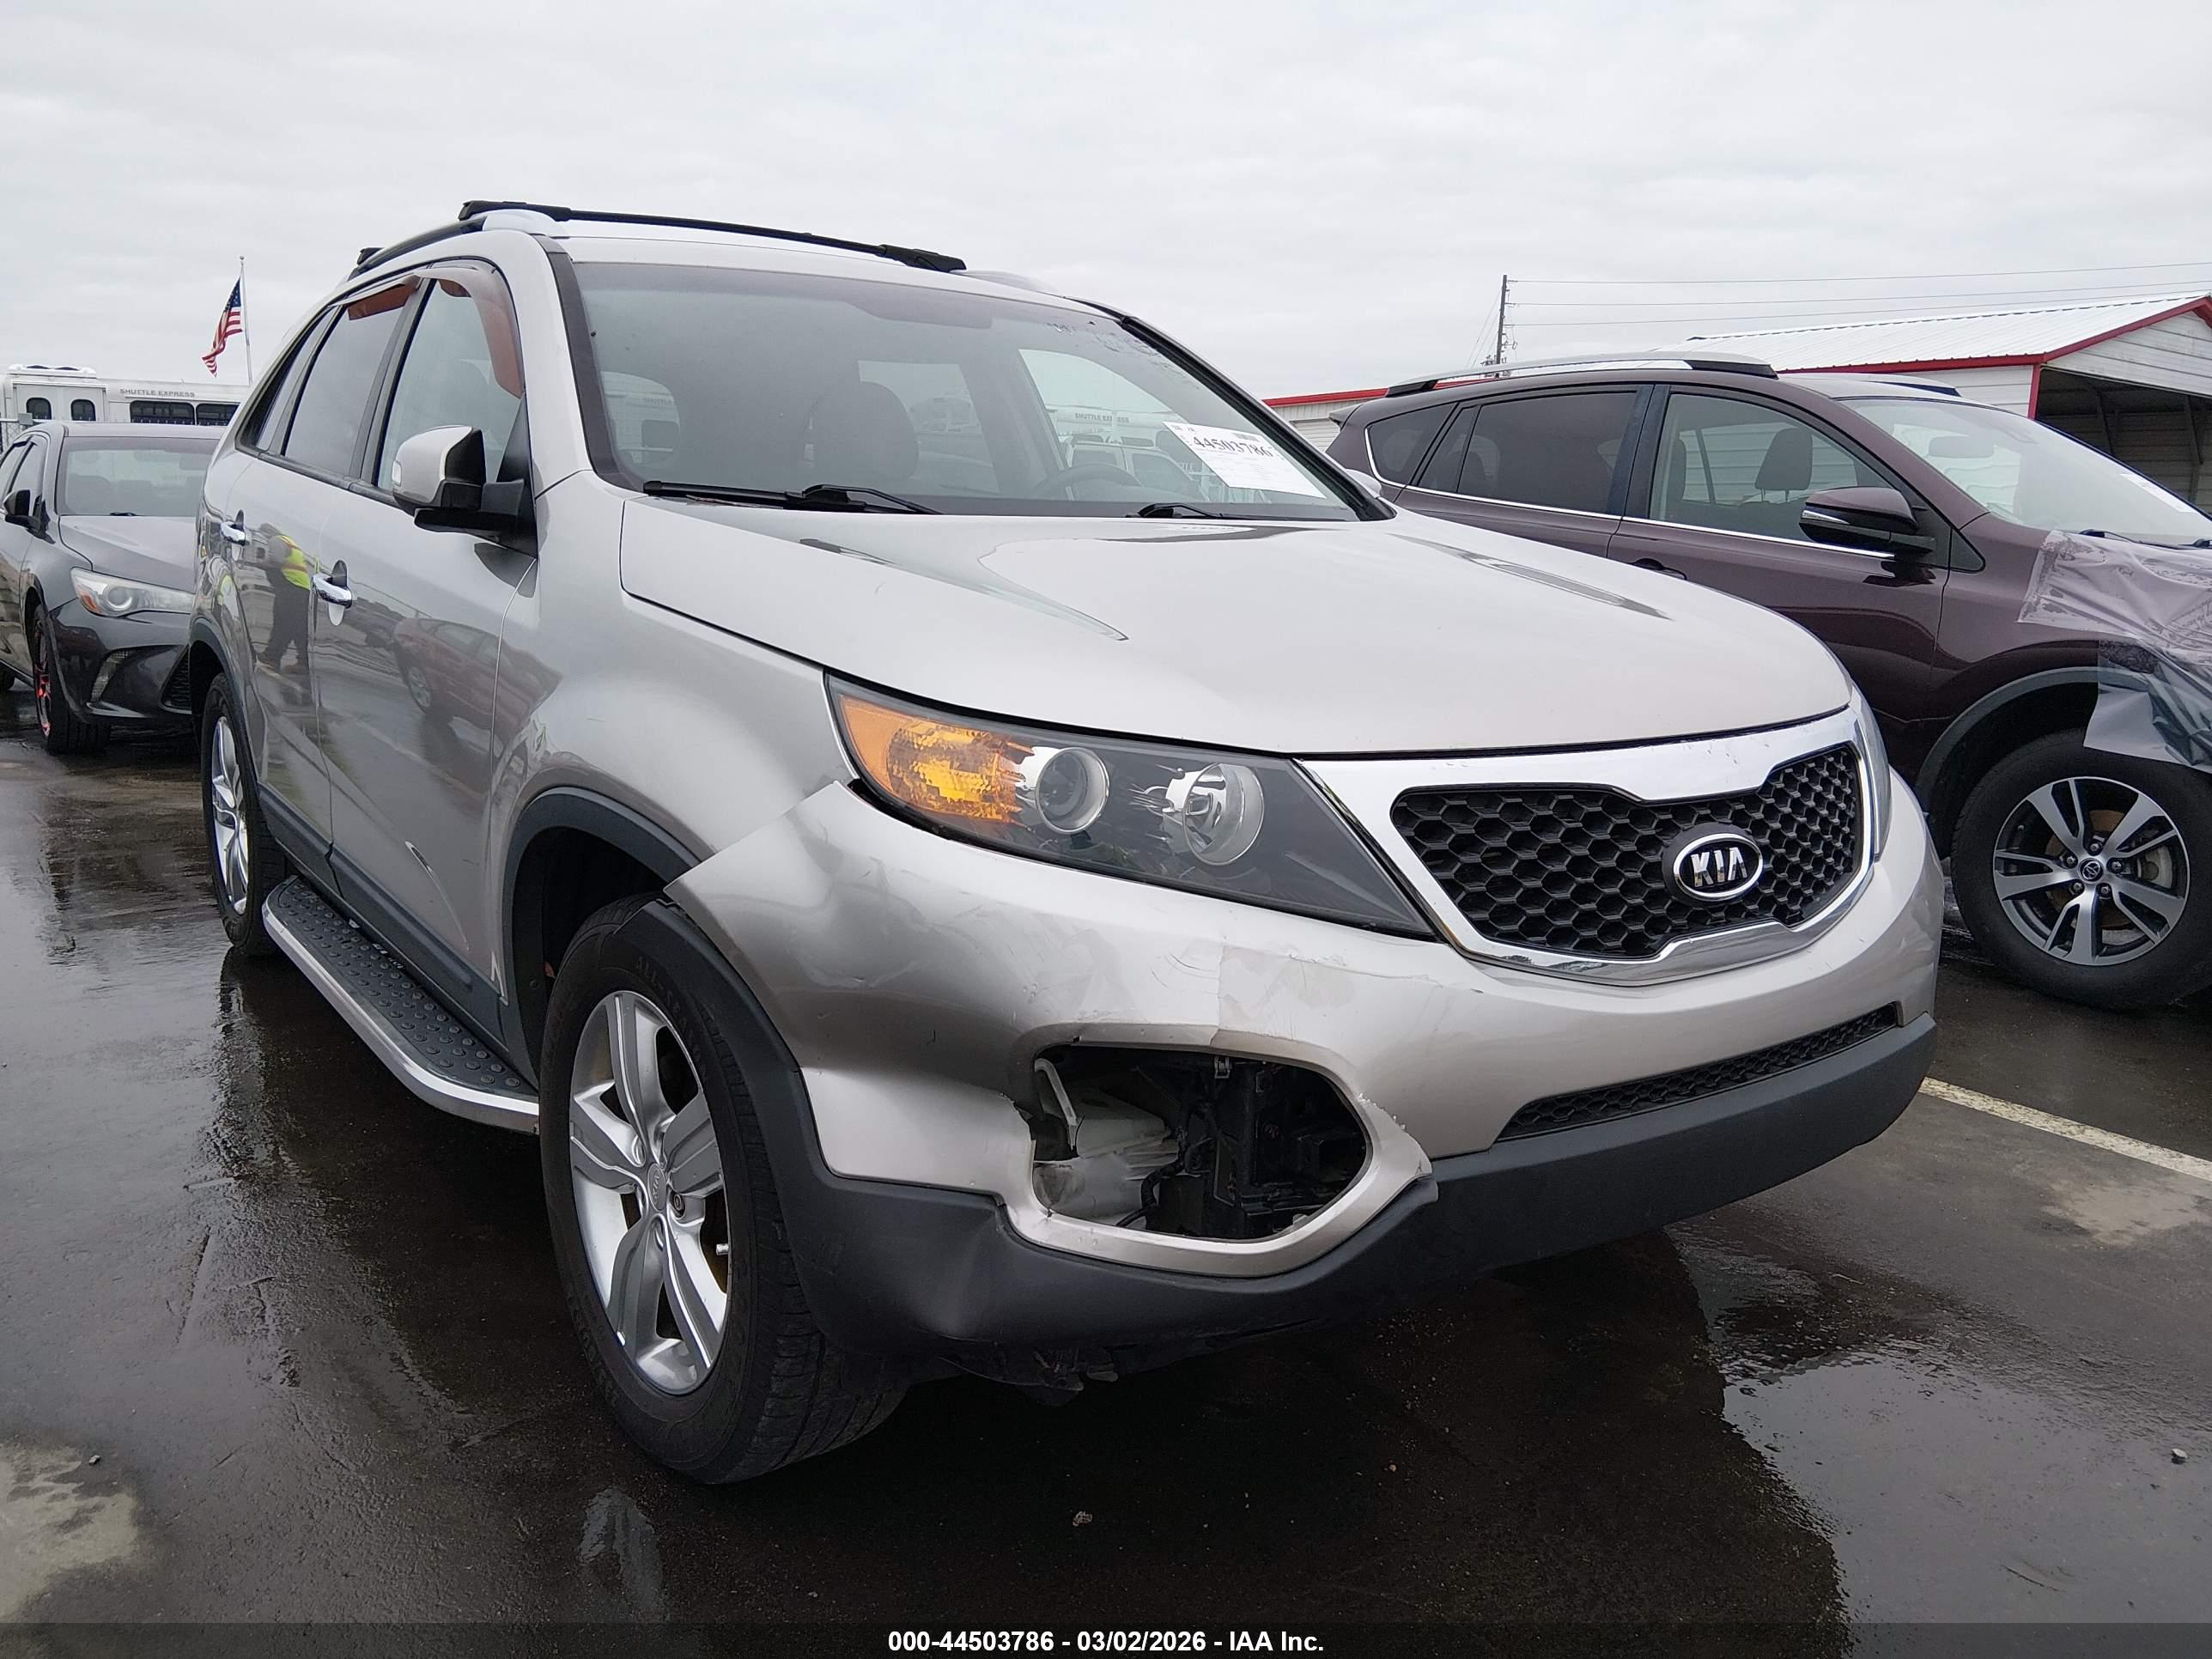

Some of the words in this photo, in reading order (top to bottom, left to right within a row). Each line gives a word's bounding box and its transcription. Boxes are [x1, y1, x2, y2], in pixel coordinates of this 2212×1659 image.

[1074, 412, 1102, 421] SHUTTLE
[1193, 436, 1273, 457] 44503786
[1690, 847, 1748, 888] KIA
